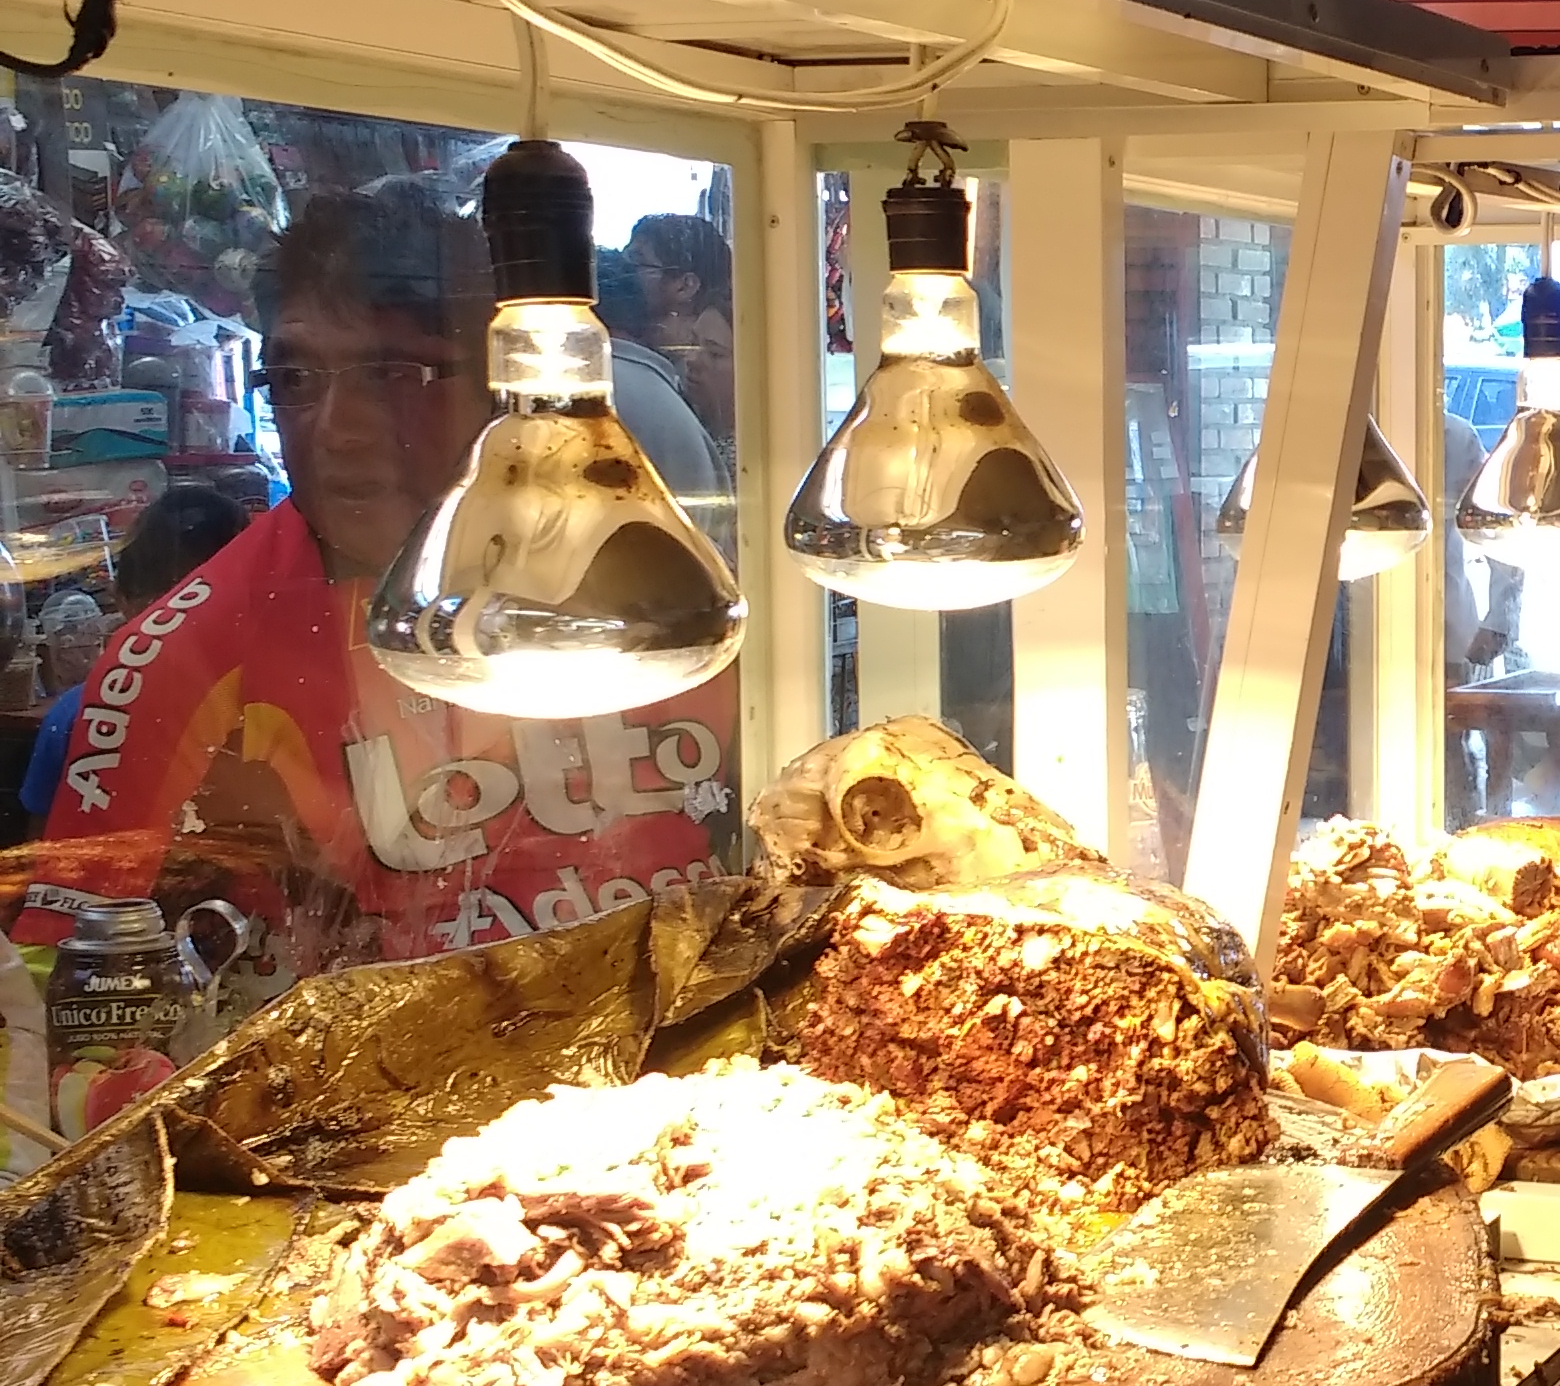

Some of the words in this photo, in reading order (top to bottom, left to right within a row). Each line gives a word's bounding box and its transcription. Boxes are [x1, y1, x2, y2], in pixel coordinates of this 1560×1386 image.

[65, 576, 213, 813] Adecco
[83, 974, 146, 992] JUMEX
[109, 1002, 181, 1024] Freco
